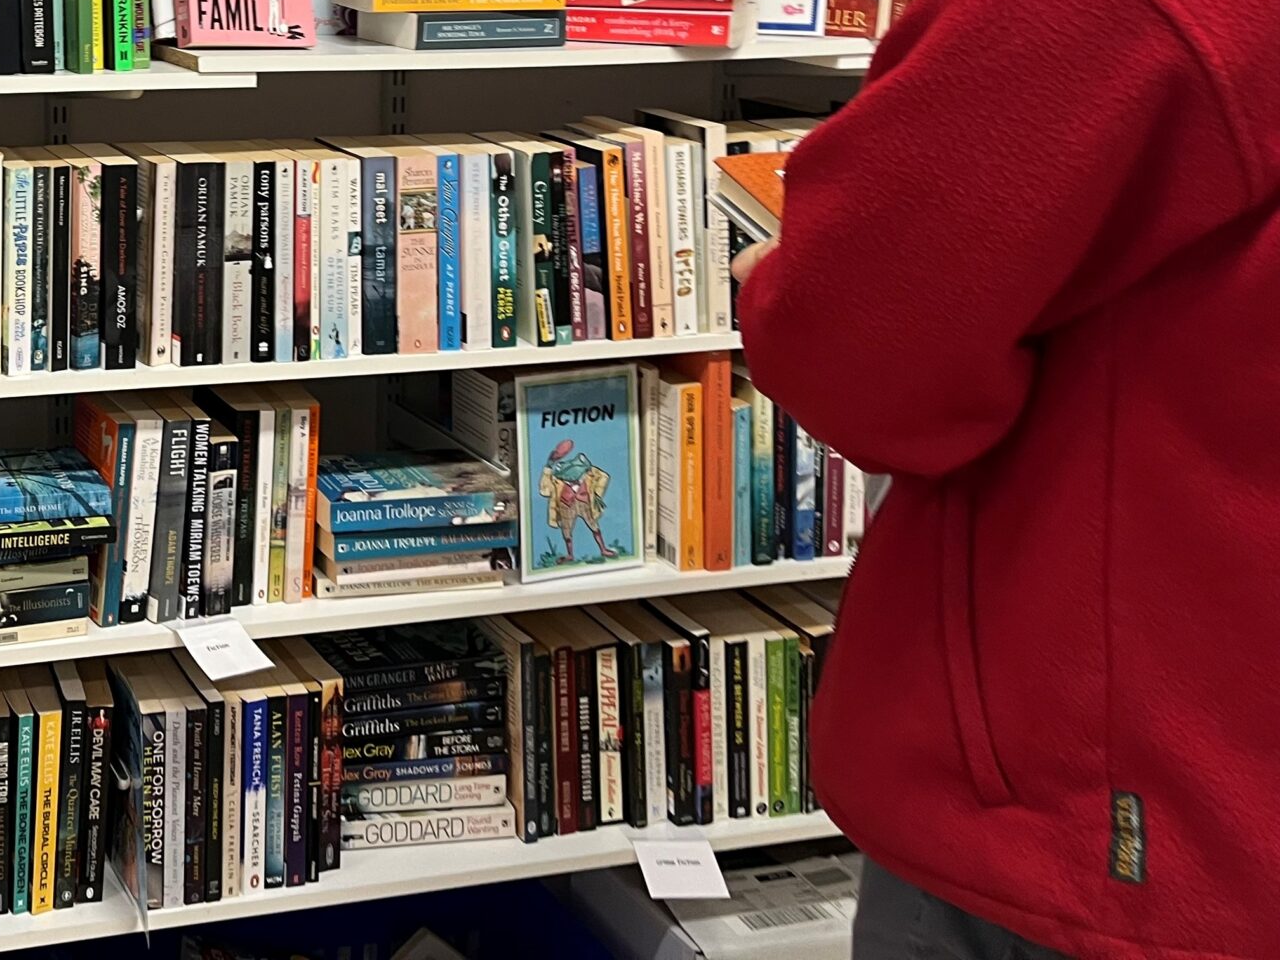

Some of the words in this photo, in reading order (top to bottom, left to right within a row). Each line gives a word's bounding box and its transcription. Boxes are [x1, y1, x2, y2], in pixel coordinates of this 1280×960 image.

[34, 9, 43, 48] PATTERSON
[257, 170, 270, 198] tony
[498, 176, 507, 191] The
[257, 202, 269, 249] parsons
[497, 196, 509, 238] Other
[374, 245, 386, 283] tamar
[498, 241, 509, 281] Guest
[541, 404, 615, 428] FICTION
[336, 507, 382, 523] Joanna
[385, 504, 435, 520] Trollope
[1, 534, 69, 550] INTELLIGENCE
[253, 708, 262, 738] TANA
[249, 740, 262, 787] FRENCH
[358, 782, 452, 809] GODDARD
[365, 817, 464, 844] GODDARD
